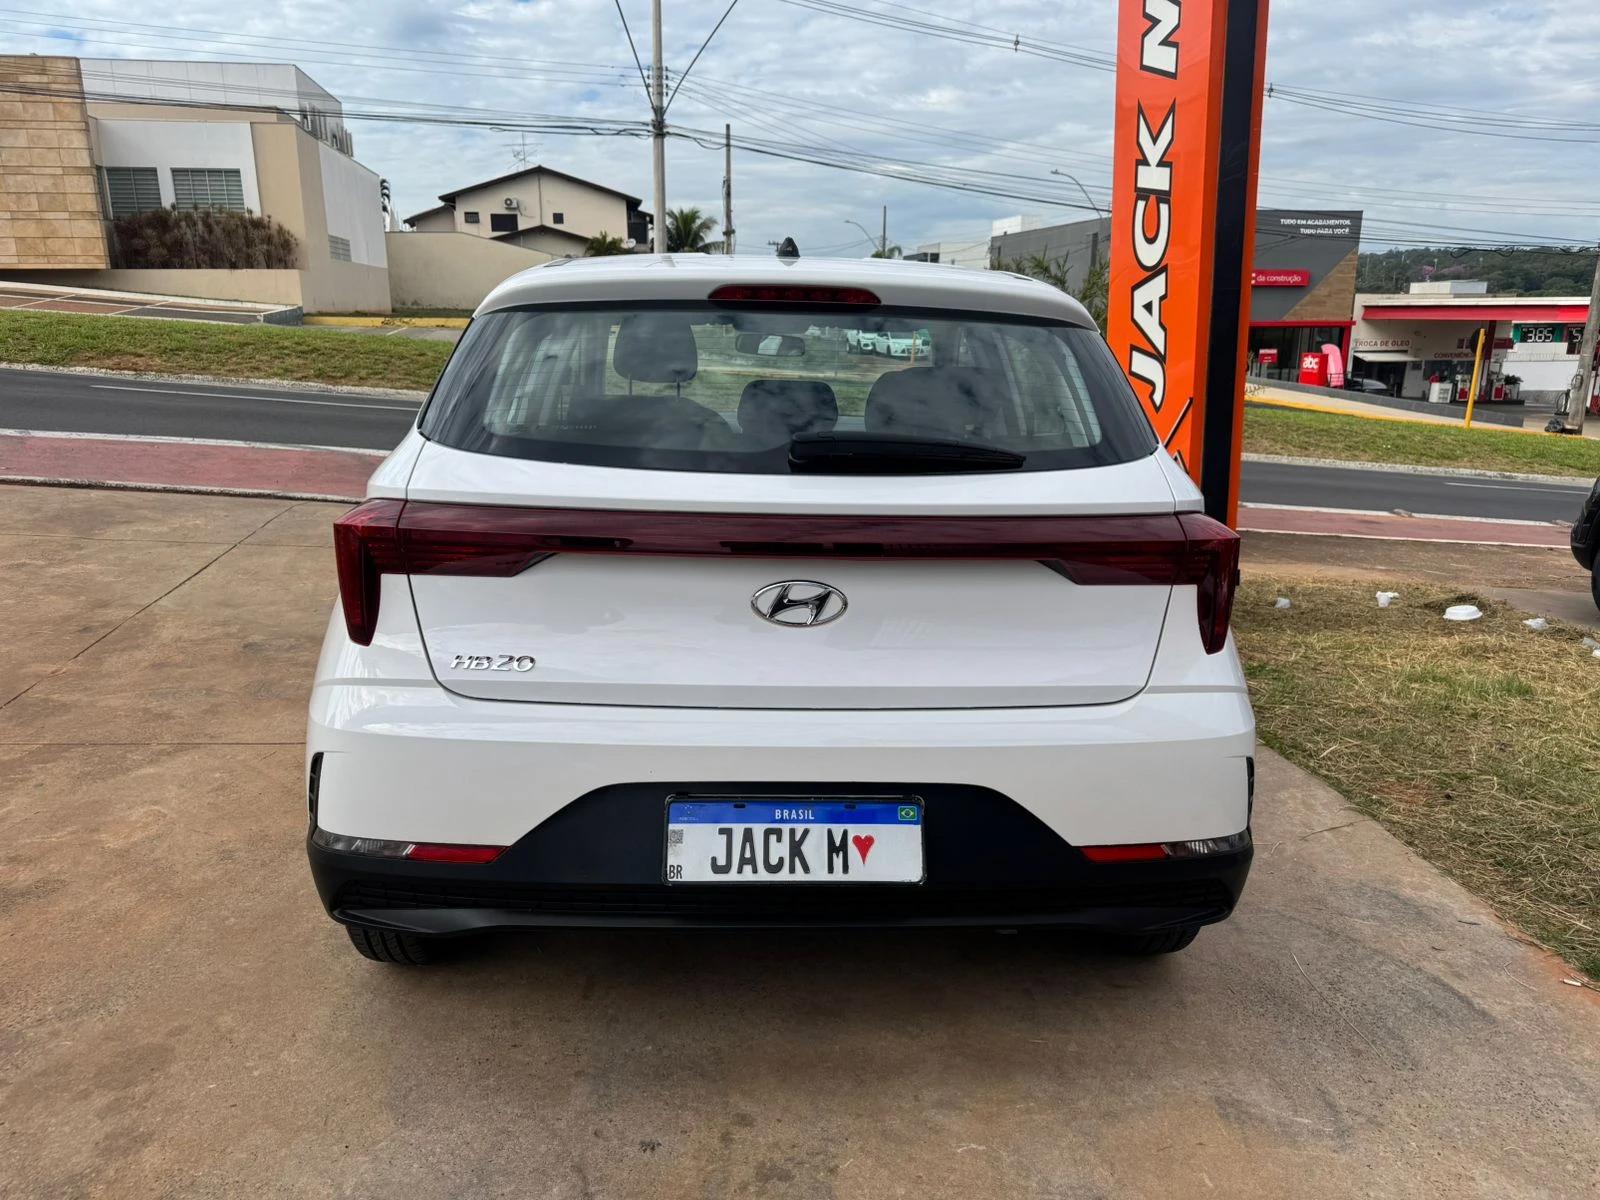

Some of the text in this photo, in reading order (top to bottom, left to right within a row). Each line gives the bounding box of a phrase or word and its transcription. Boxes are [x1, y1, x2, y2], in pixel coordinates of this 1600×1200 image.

[1129, 97, 1177, 414] JACK
[1256, 274, 1265, 282] da
[1266, 273, 1301, 284] construção
[1302, 355, 1320, 369] abc
[450, 654, 536, 672] HB20
[775, 808, 815, 820] BRASIL
[710, 827, 850, 875] JACK M
[668, 864, 683, 880] BR
